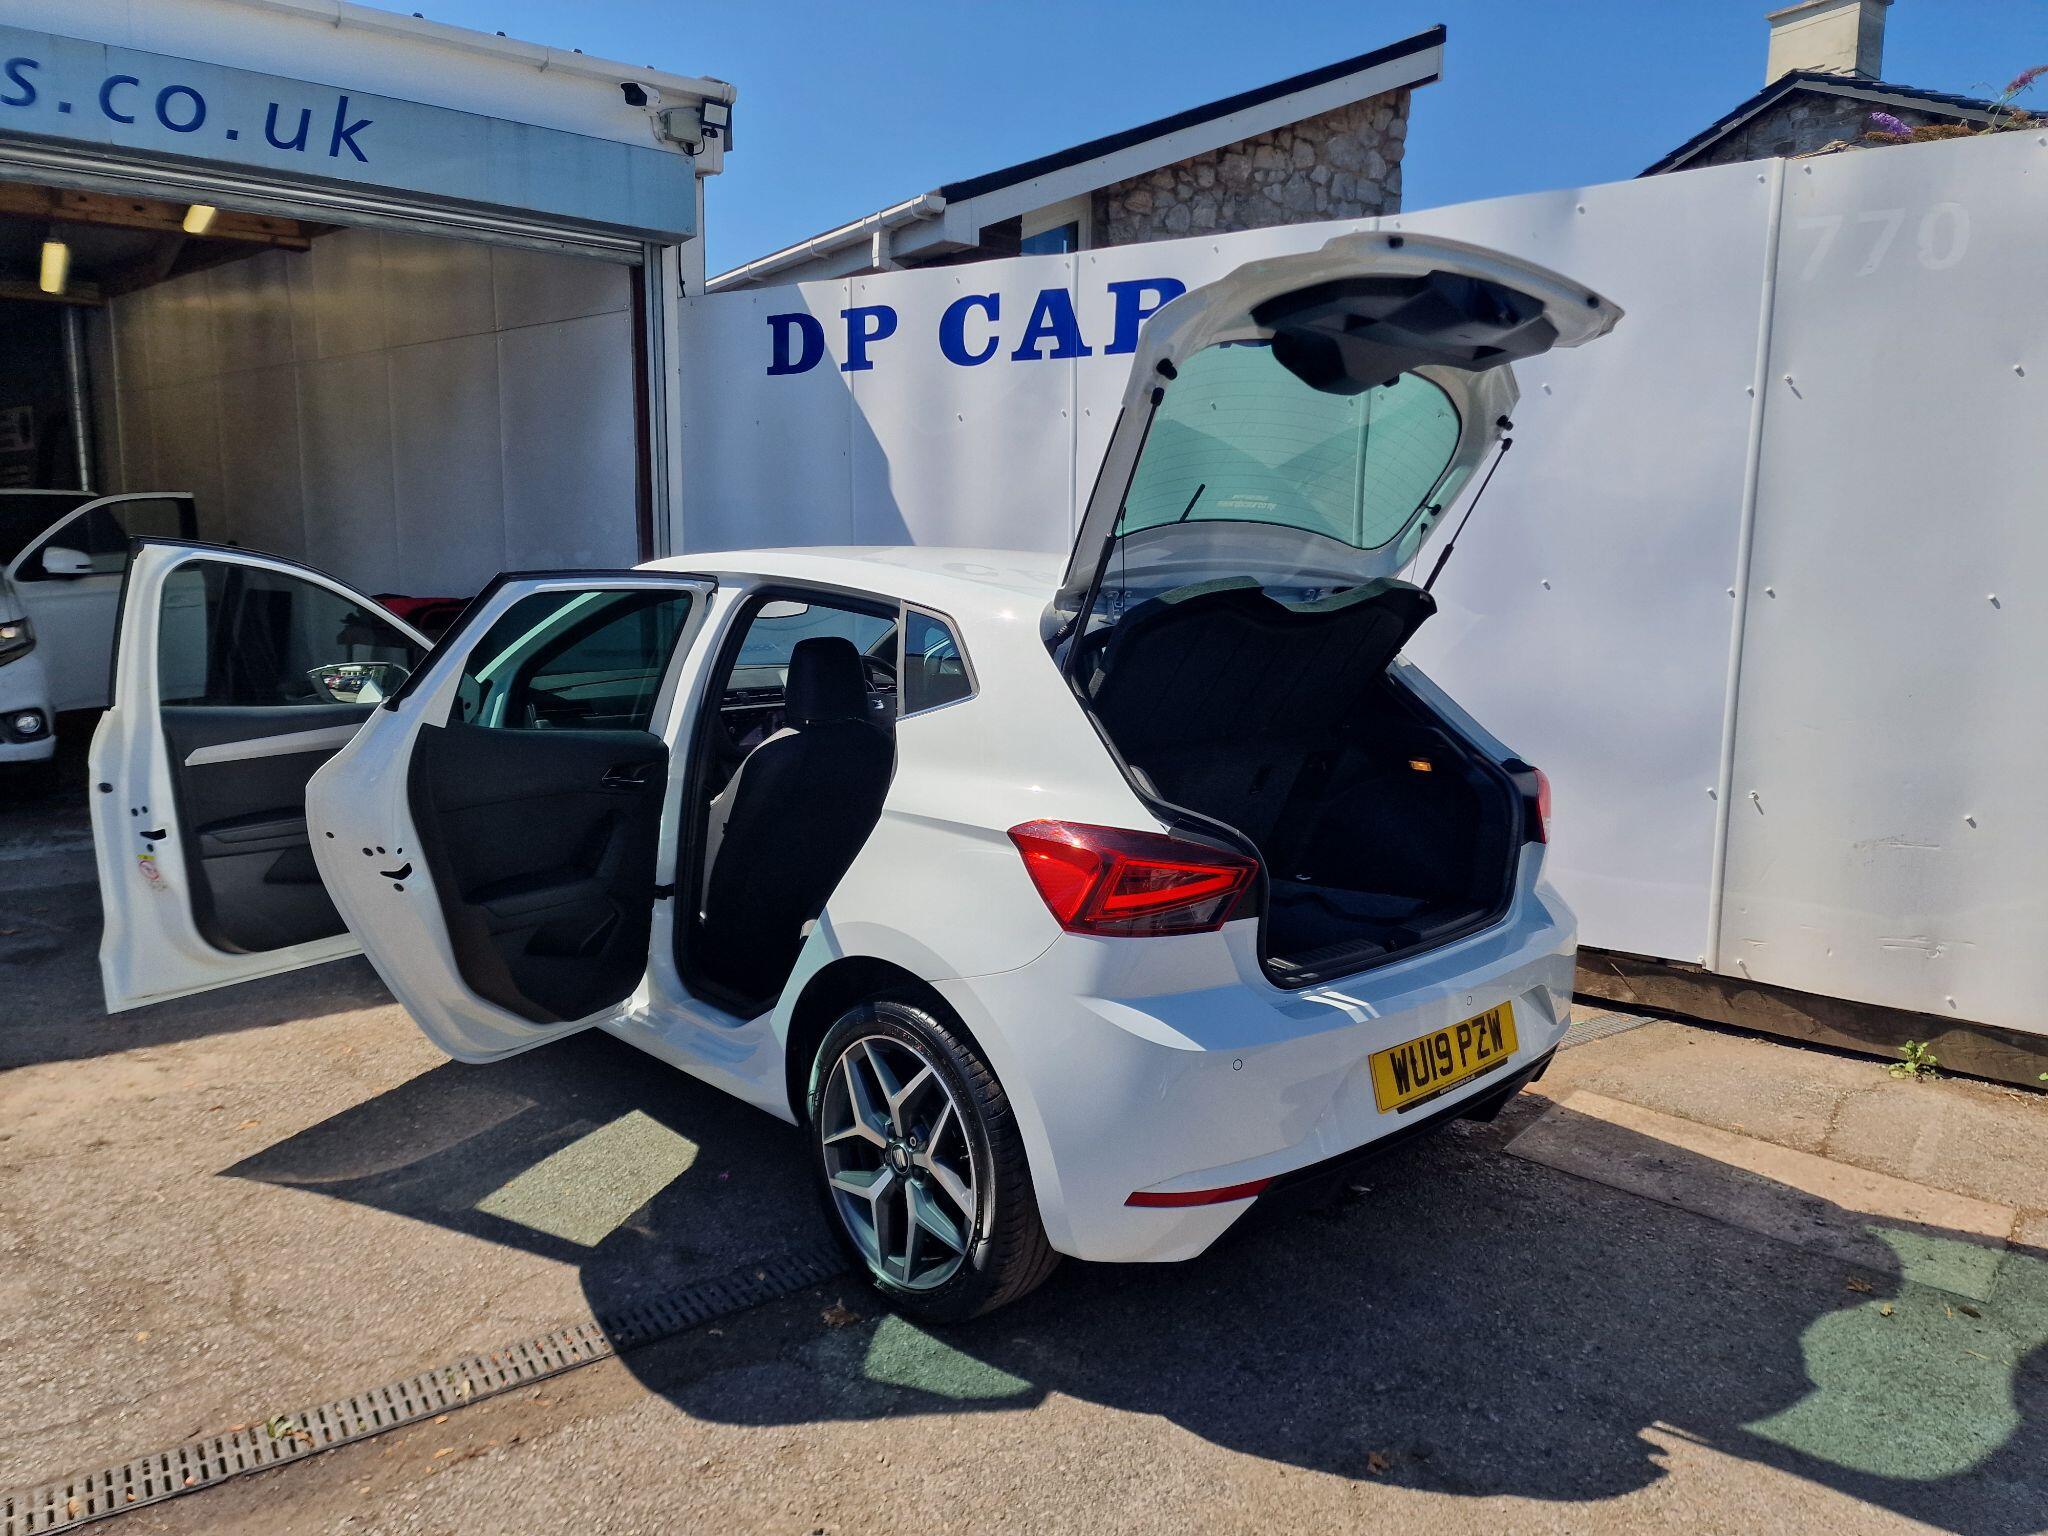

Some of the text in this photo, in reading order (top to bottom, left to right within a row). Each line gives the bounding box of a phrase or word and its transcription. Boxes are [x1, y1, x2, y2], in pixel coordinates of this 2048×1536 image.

[0, 57, 374, 163] s.co.uk
[1794, 202, 1971, 282] 770
[766, 304, 898, 376] DP
[1390, 1009, 1503, 1096] WU19 PZW
